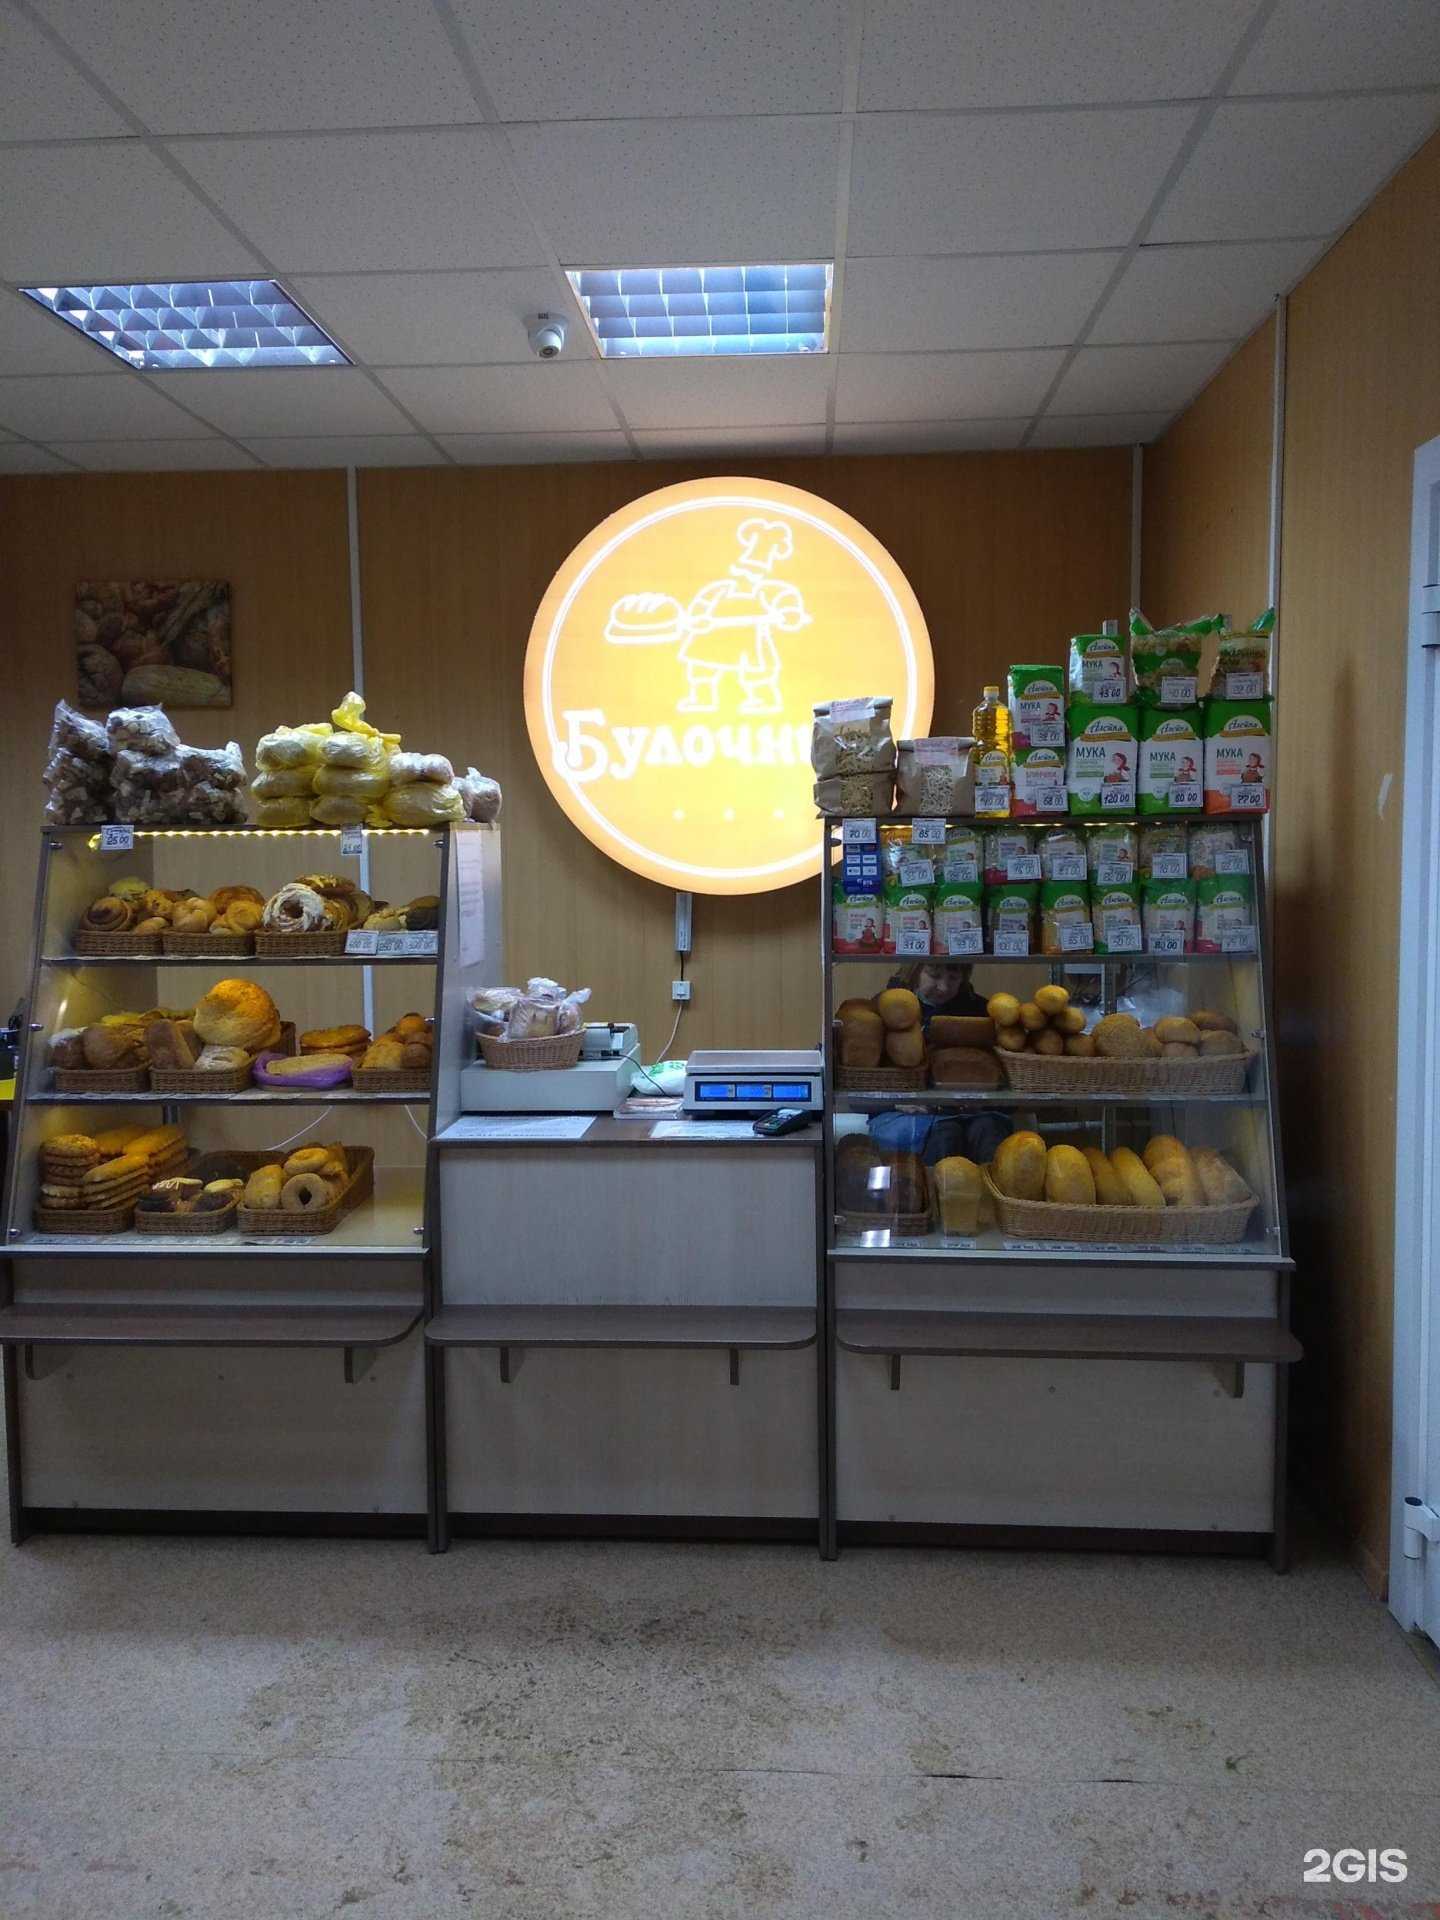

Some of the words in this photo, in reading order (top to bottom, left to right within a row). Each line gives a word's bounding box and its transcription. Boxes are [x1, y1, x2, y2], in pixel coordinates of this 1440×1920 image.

[1081, 660, 1103, 668] МУКА
[1020, 702, 1041, 710] МУКА
[1075, 746, 1106, 758] МУКА
[1149, 751, 1177, 761] МУКА
[1216, 748, 1244, 759] МУКА
